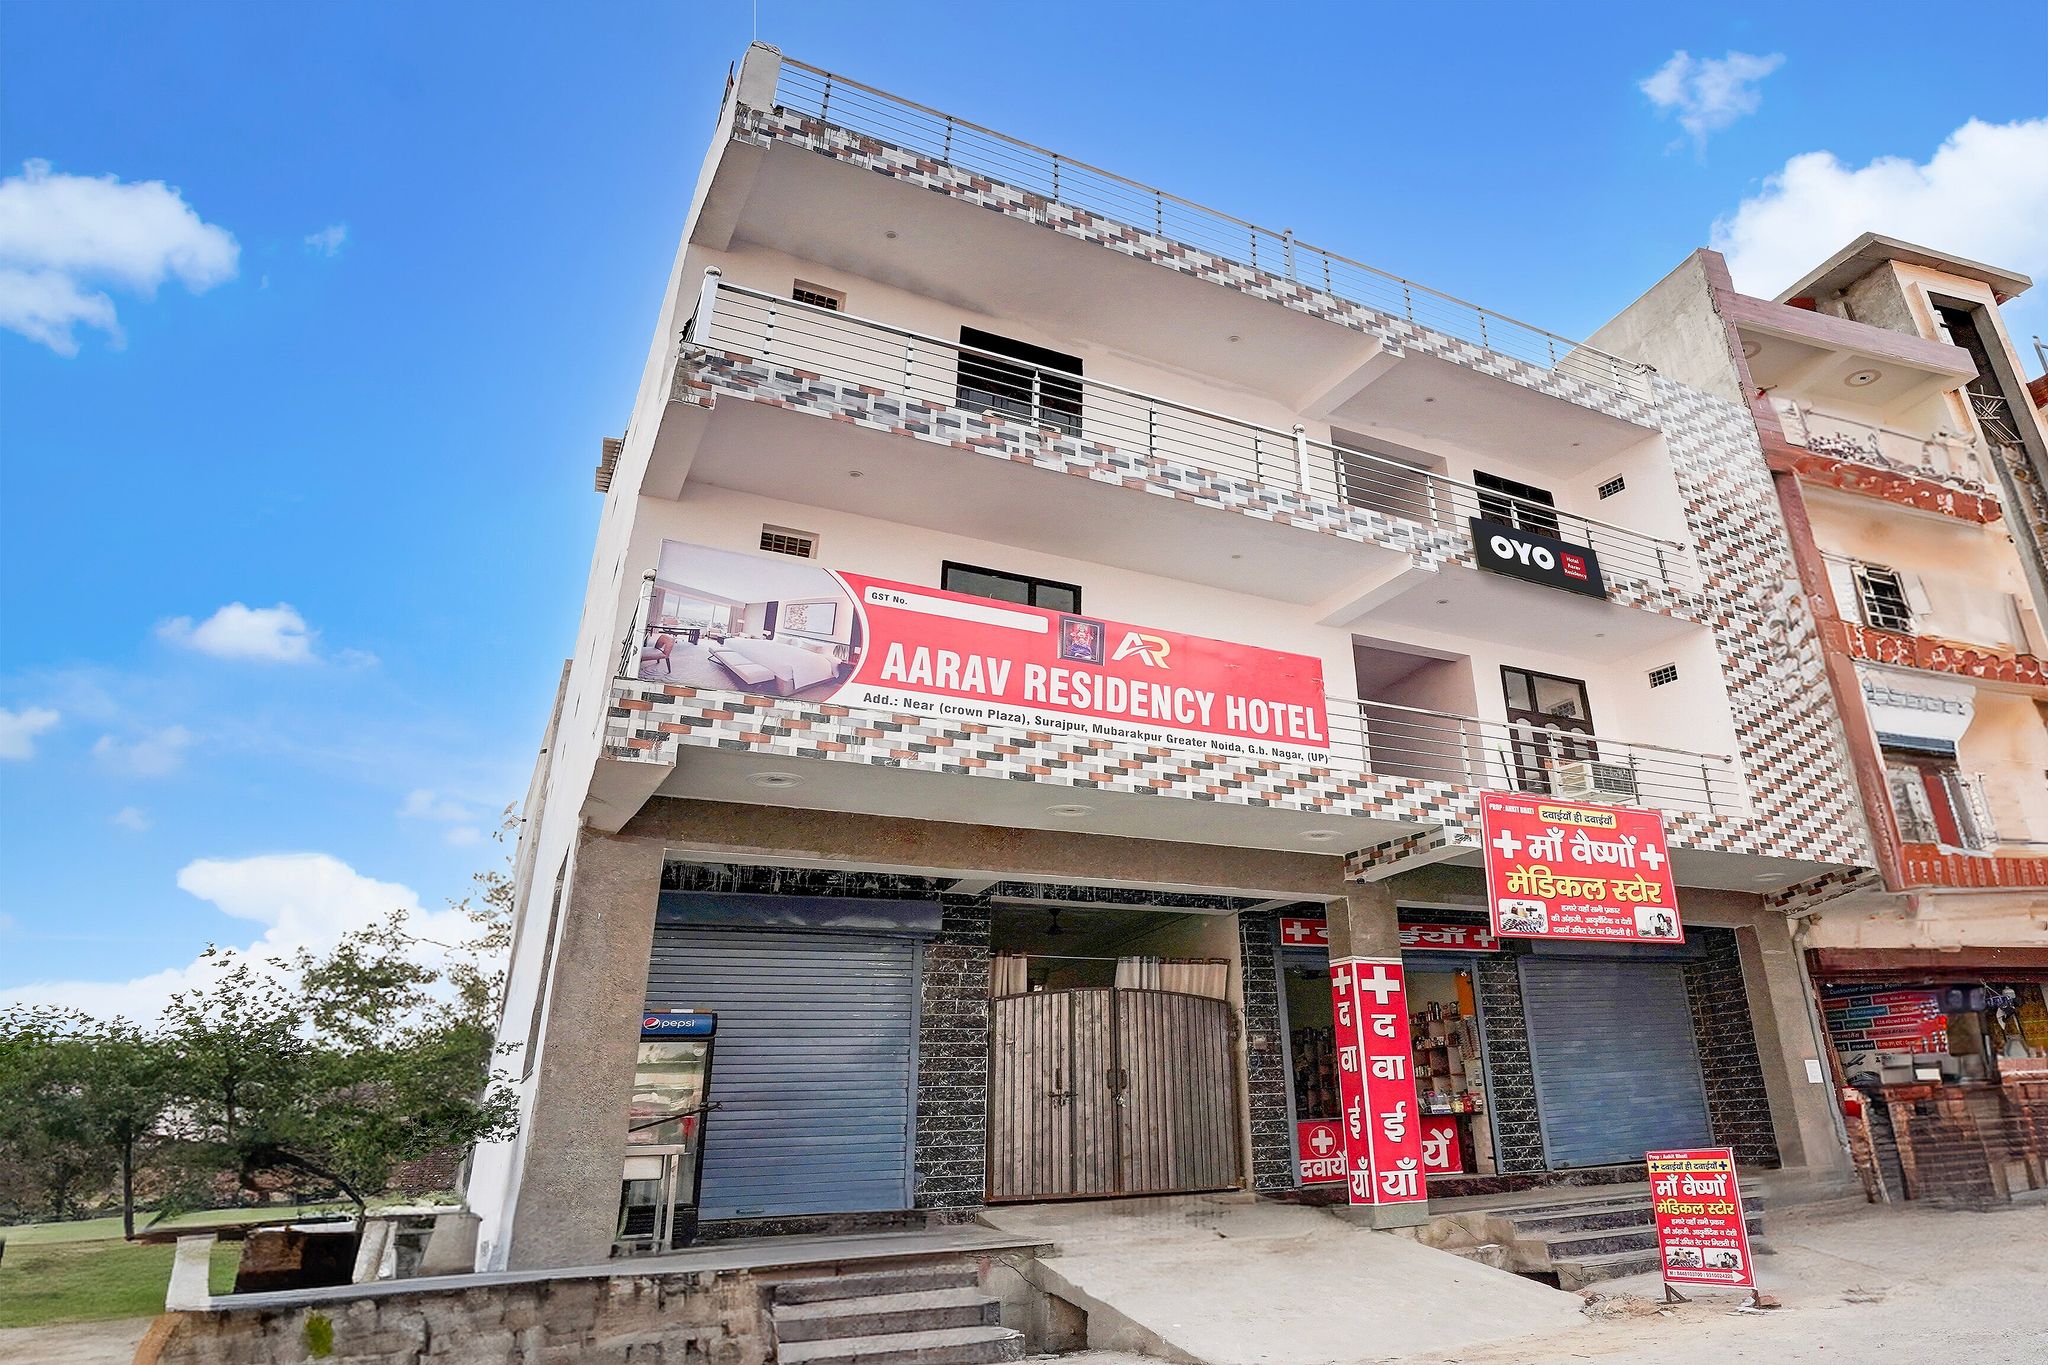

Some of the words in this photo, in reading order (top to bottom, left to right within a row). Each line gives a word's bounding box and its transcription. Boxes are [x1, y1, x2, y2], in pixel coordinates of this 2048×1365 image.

[1490, 535, 1555, 570] OYO
[1566, 555, 1580, 564] Hotel
[871, 591, 889, 602] GST
[892, 595, 908, 605] No.
[880, 642, 1012, 697] AARAV
[1023, 663, 1215, 727] RESIDENCY
[1226, 694, 1324, 741] HOTEL
[863, 692, 898, 707] Add.:
[903, 698, 935, 711] Near
[939, 702, 984, 718] (crown
[987, 708, 1031, 726] Plaza),
[1034, 715, 1088, 733] Surajpur,
[1092, 723, 1163, 743] Mubarakpur
[1166, 734, 1207, 750] Greater
[1211, 740, 1245, 754] Noida,
[1248, 745, 1269, 757] G.b.
[1271, 748, 1304, 762] Nagar,
[1307, 752, 1329, 764] (UP)
[1541, 810, 1572, 822] दवाईयाँ
[1574, 811, 1582, 823] ही
[1584, 814, 1613, 826] दवाईयाँ
[1526, 826, 1565, 863] माँ
[1569, 829, 1638, 868] वैष्णों
[1505, 864, 1607, 900] मेडिकल
[1610, 873, 1662, 904] स्टोर
[1829, 985, 1859, 995] Customer
[1860, 983, 1883, 992] Service
[661, 1019, 695, 1029] pepsi
[1685, 1161, 1692, 1171] ही
[1655, 1173, 1679, 1197] माँ
[1681, 1172, 1728, 1197] वैष्णों
[1656, 1198, 1705, 1215] मेडिकल
[1706, 1199, 1735, 1215] स्टोर
